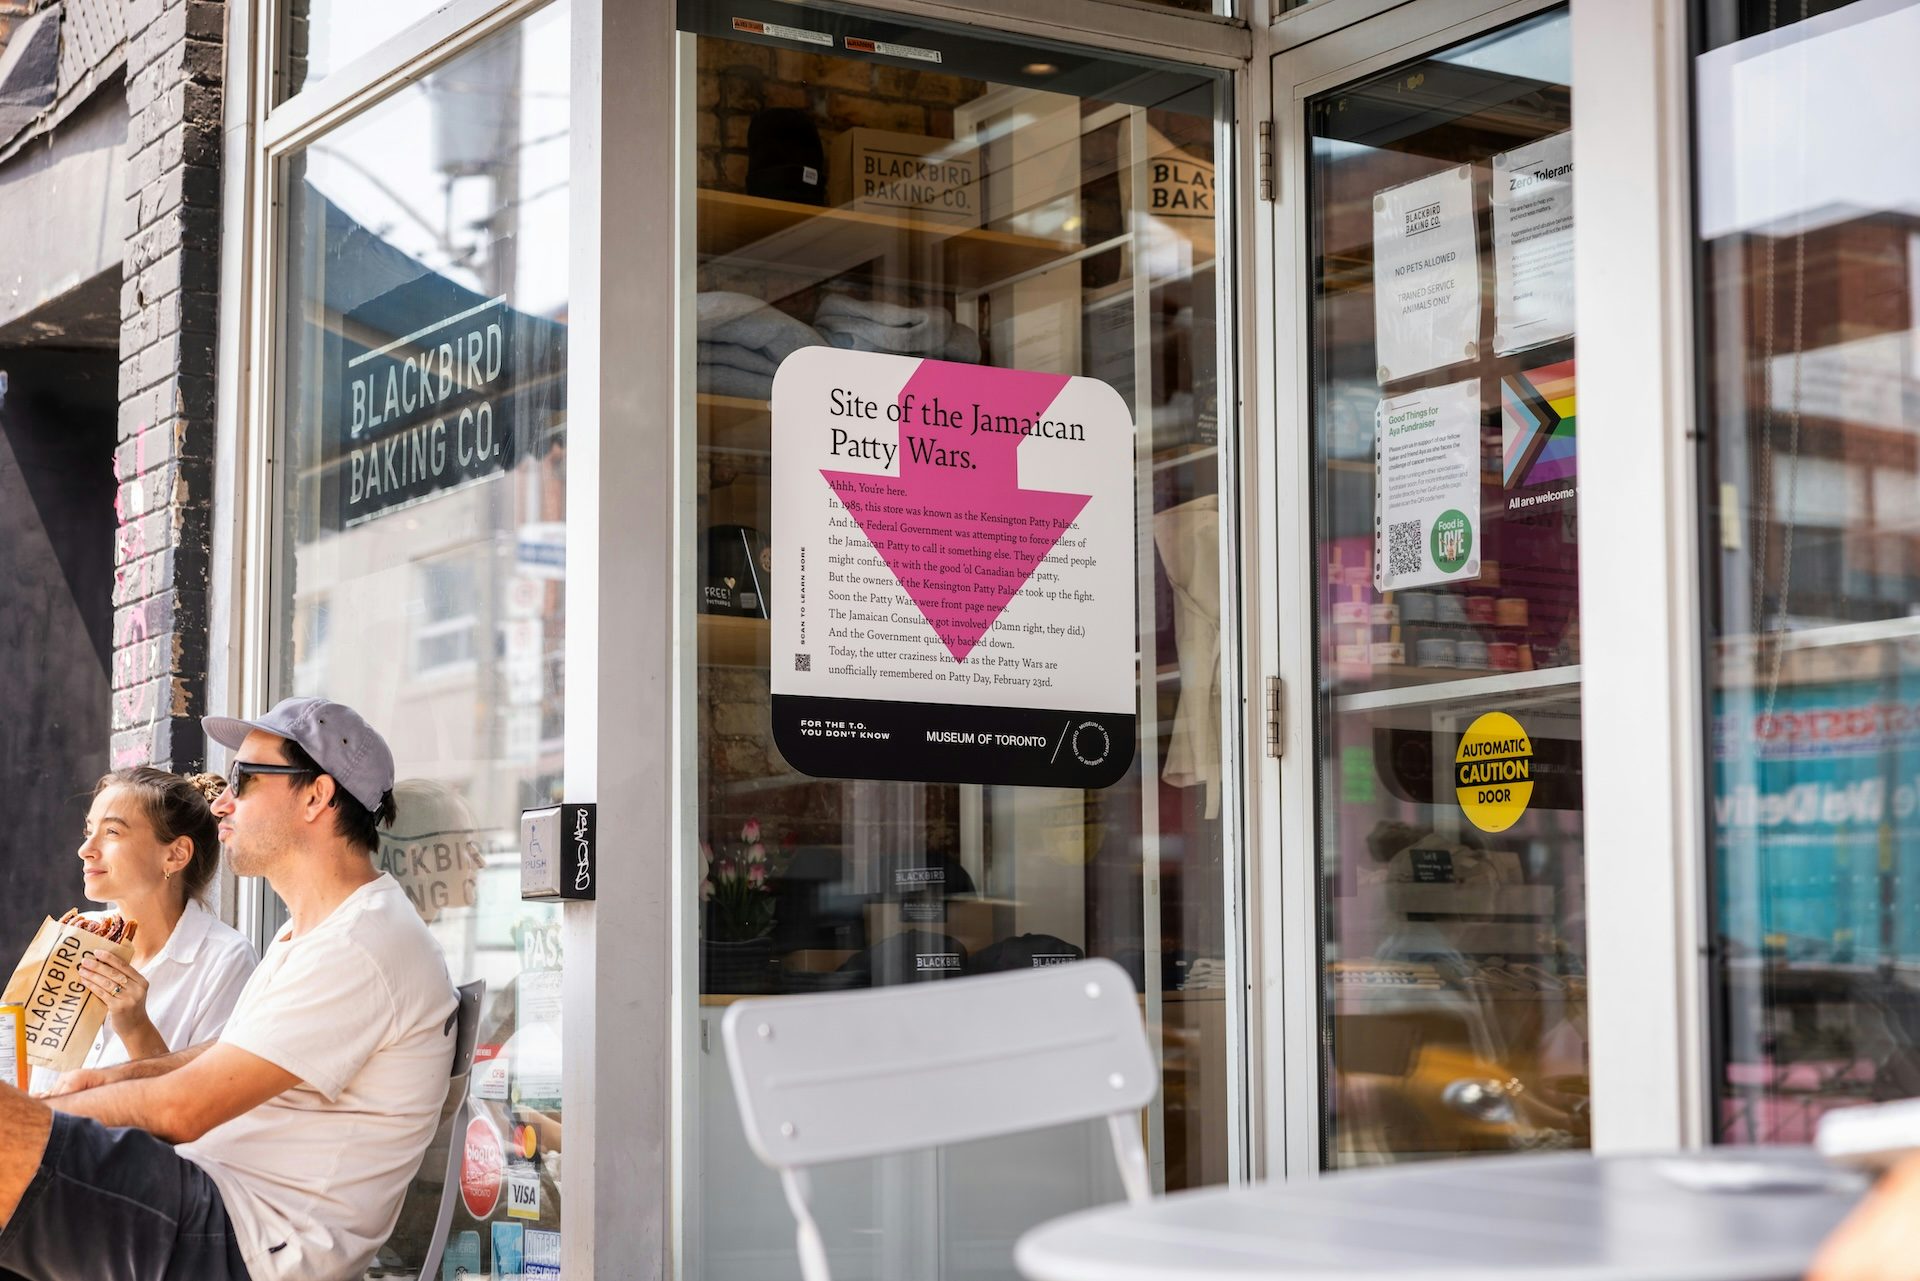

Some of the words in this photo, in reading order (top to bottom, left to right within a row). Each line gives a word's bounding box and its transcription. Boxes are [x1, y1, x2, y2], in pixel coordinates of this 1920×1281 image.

[864, 155, 971, 186] BLACKBIRD
[864, 179, 935, 204] BAKING
[943, 188, 971, 209] CO.
[1509, 176, 1533, 191] Zero
[1405, 205, 1441, 224] BLACKBIRD
[1405, 219, 1429, 234] BAKING
[1430, 215, 1441, 226] CO.
[1394, 266, 1406, 277] NO
[1406, 261, 1423, 274] PETS
[1423, 251, 1456, 269] ALLOWED
[1398, 287, 1426, 302] TRAINED
[1427, 279, 1455, 295] SERVICE
[1402, 299, 1432, 315] ANIMALS
[1432, 294, 1451, 308] ONLY
[351, 323, 501, 434] BLACKBIRD
[830, 387, 878, 420] Site
[886, 394, 915, 424] of
[921, 397, 963, 428] the
[970, 404, 1086, 440] Jamaican
[1388, 413, 1405, 424] Good
[1406, 409, 1428, 419] Things
[1428, 406, 1439, 415] for
[1388, 427, 1400, 437] Aya
[1401, 420, 1435, 433] Fundraiser
[350, 418, 446, 505] BAKING
[458, 401, 500, 467] CO.
[830, 428, 898, 468] Patty
[905, 435, 976, 470] Wars.
[829, 480, 856, 494] Ahhh,
[886, 485, 907, 496] here.
[1509, 497, 1520, 510] All
[1520, 496, 1535, 507] are
[1535, 488, 1574, 504] welcome
[828, 498, 838, 508] In
[840, 500, 863, 514] 1985,
[864, 501, 881, 512] this
[882, 505, 904, 514] store
[905, 507, 921, 516] was
[922, 506, 952, 519] known
[964, 510, 978, 520] the
[980, 511, 1027, 526] Kensington
[1029, 516, 1050, 529] Patty
[1052, 518, 1080, 530] Palace.
[1438, 519, 1456, 531] Food
[1457, 518, 1464, 528] is
[828, 516, 848, 527] And
[849, 517, 864, 530] the
[866, 519, 898, 532] Federal
[899, 522, 952, 536] Government
[954, 530, 970, 538] was
[972, 531, 1017, 544] attempting
[1018, 535, 1028, 543] to
[1029, 533, 1050, 545] force
[1051, 535, 1076, 547] sellers
[1077, 537, 1087, 548] of
[1438, 528, 1464, 557] LOVE
[828, 534, 843, 545] the
[844, 535, 884, 549] Jamaican
[887, 539, 909, 553] Patty
[911, 543, 920, 552] to
[922, 543, 937, 553] call
[939, 544, 945, 554] it
[948, 546, 992, 560] something
[993, 548, 1011, 559] else.
[1013, 550, 1035, 564] They
[1036, 552, 1068, 564] claimed
[1070, 556, 1096, 568] people
[828, 553, 854, 567] might
[856, 555, 892, 569] confuse
[893, 559, 899, 568] it
[901, 559, 921, 570] with
[923, 560, 938, 571] the
[939, 563, 960, 575] good
[974, 565, 1014, 577] Canadian
[1016, 567, 1035, 579] beef
[1036, 572, 1060, 583] patty.
[828, 571, 844, 582] But
[846, 572, 861, 584] the
[862, 576, 893, 586] owners
[895, 575, 905, 588] of
[906, 577, 920, 588] the
[922, 578, 971, 593] Kensington
[973, 582, 995, 596] Patty
[998, 584, 1024, 596] Palace
[1025, 587, 1044, 597] took
[1046, 591, 1057, 601] up
[1058, 589, 1072, 600] the
[1073, 589, 1094, 603] fight.
[800, 606, 806, 618] TO
[828, 589, 850, 601] Soon
[852, 591, 868, 602] the
[870, 592, 893, 607] Patty
[894, 594, 918, 606] Wars
[917, 599, 939, 608] were
[940, 598, 962, 609] front
[964, 603, 984, 613] page
[986, 604, 1010, 613] news.
[828, 608, 846, 619] The
[848, 609, 888, 622] Jamaican
[890, 612, 934, 626] Consulate
[935, 618, 949, 628] got
[951, 617, 989, 630] involved.
[990, 619, 1021, 632] (Damn
[1022, 622, 1045, 635] right,
[1046, 623, 1065, 637] they
[1066, 625, 1086, 638] did.)
[828, 627, 848, 638] And
[850, 627, 865, 639] the
[866, 629, 921, 643] Government
[923, 633, 955, 648] quickly
[957, 634, 987, 647] backed
[989, 637, 1015, 649] down.
[828, 645, 858, 659] Today,
[859, 646, 874, 658] the
[876, 651, 897, 659] utter
[898, 651, 938, 662] craziness
[939, 651, 969, 664] known
[970, 657, 980, 665] as
[981, 655, 996, 666] the
[998, 656, 1020, 669] Patty
[1022, 657, 1043, 669] Wars
[1044, 662, 1058, 670] are
[828, 664, 878, 679] unofficially
[879, 668, 933, 680] remembered
[934, 673, 946, 681] on
[948, 671, 971, 685] Patty
[973, 672, 992, 686] Day,
[993, 673, 1031, 688] February
[1032, 676, 1052, 687] 23rd.
[800, 720, 822, 728] FOR
[825, 721, 845, 729] THE
[848, 722, 867, 730] T.O.
[800, 728, 822, 736] YOU
[825, 730, 856, 738] DON'T
[926, 731, 974, 744] MUSEUM
[978, 733, 992, 744] OF
[995, 734, 1046, 747] TORONTO
[1462, 738, 1525, 758] AUTOMATIC
[1460, 759, 1529, 784] CAUTION
[1478, 789, 1511, 804] DOOR
[896, 871, 945, 882] BLACKBIRD
[25, 936, 81, 1044] BLACKBIRD
[41, 981, 86, 1049] BAKING
[512, 1184, 536, 1205] VISA
